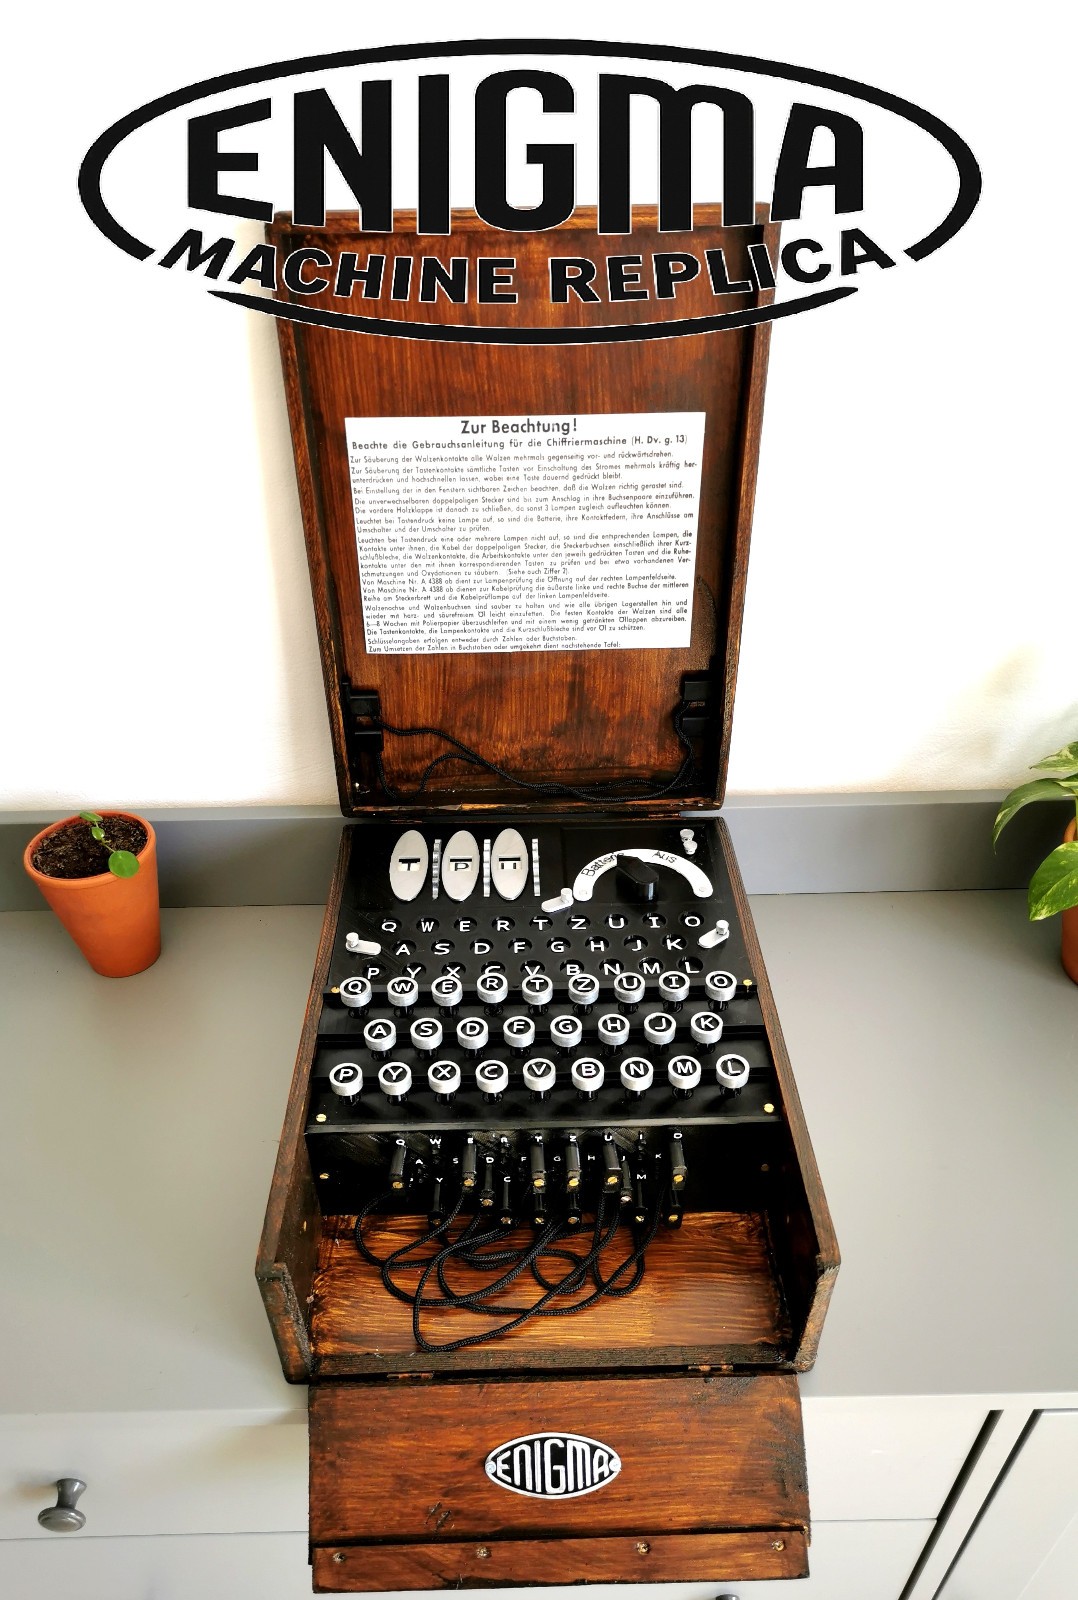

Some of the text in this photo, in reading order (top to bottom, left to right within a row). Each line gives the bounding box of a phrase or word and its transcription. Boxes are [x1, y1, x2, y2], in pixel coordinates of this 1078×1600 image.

[460, 418, 577, 435] Zur Beachtung!
[352, 440, 388, 450] Beachte
[393, 440, 407, 449] die
[412, 438, 505, 451] Gebrauchsanleitung
[510, 438, 523, 447] für
[528, 438, 542, 447] die
[547, 436, 627, 446] Chiffriermaschine
[647, 435, 662, 445] Dv.
[664, 438, 673, 447] g.
[652, 850, 676, 863] Aus
[455, 862, 469, 871] P
[382, 916, 700, 932] Q W E R T Z U I O
[396, 939, 682, 955] A S D F G H J K
[368, 968, 379, 979] P
[407, 966, 422, 979] Y
[447, 966, 460, 978] X
[525, 966, 540, 976] V
[566, 964, 580, 975] B
[604, 963, 620, 975] N
[643, 963, 660, 974] M
[685, 962, 699, 973] L
[348, 976, 728, 993] Q W E R T Z U I O
[372, 1017, 714, 1036] A S D F G H J K
[339, 1060, 741, 1080] P Y X C V B N M L
[496, 1438, 610, 1494] ENIGMA
